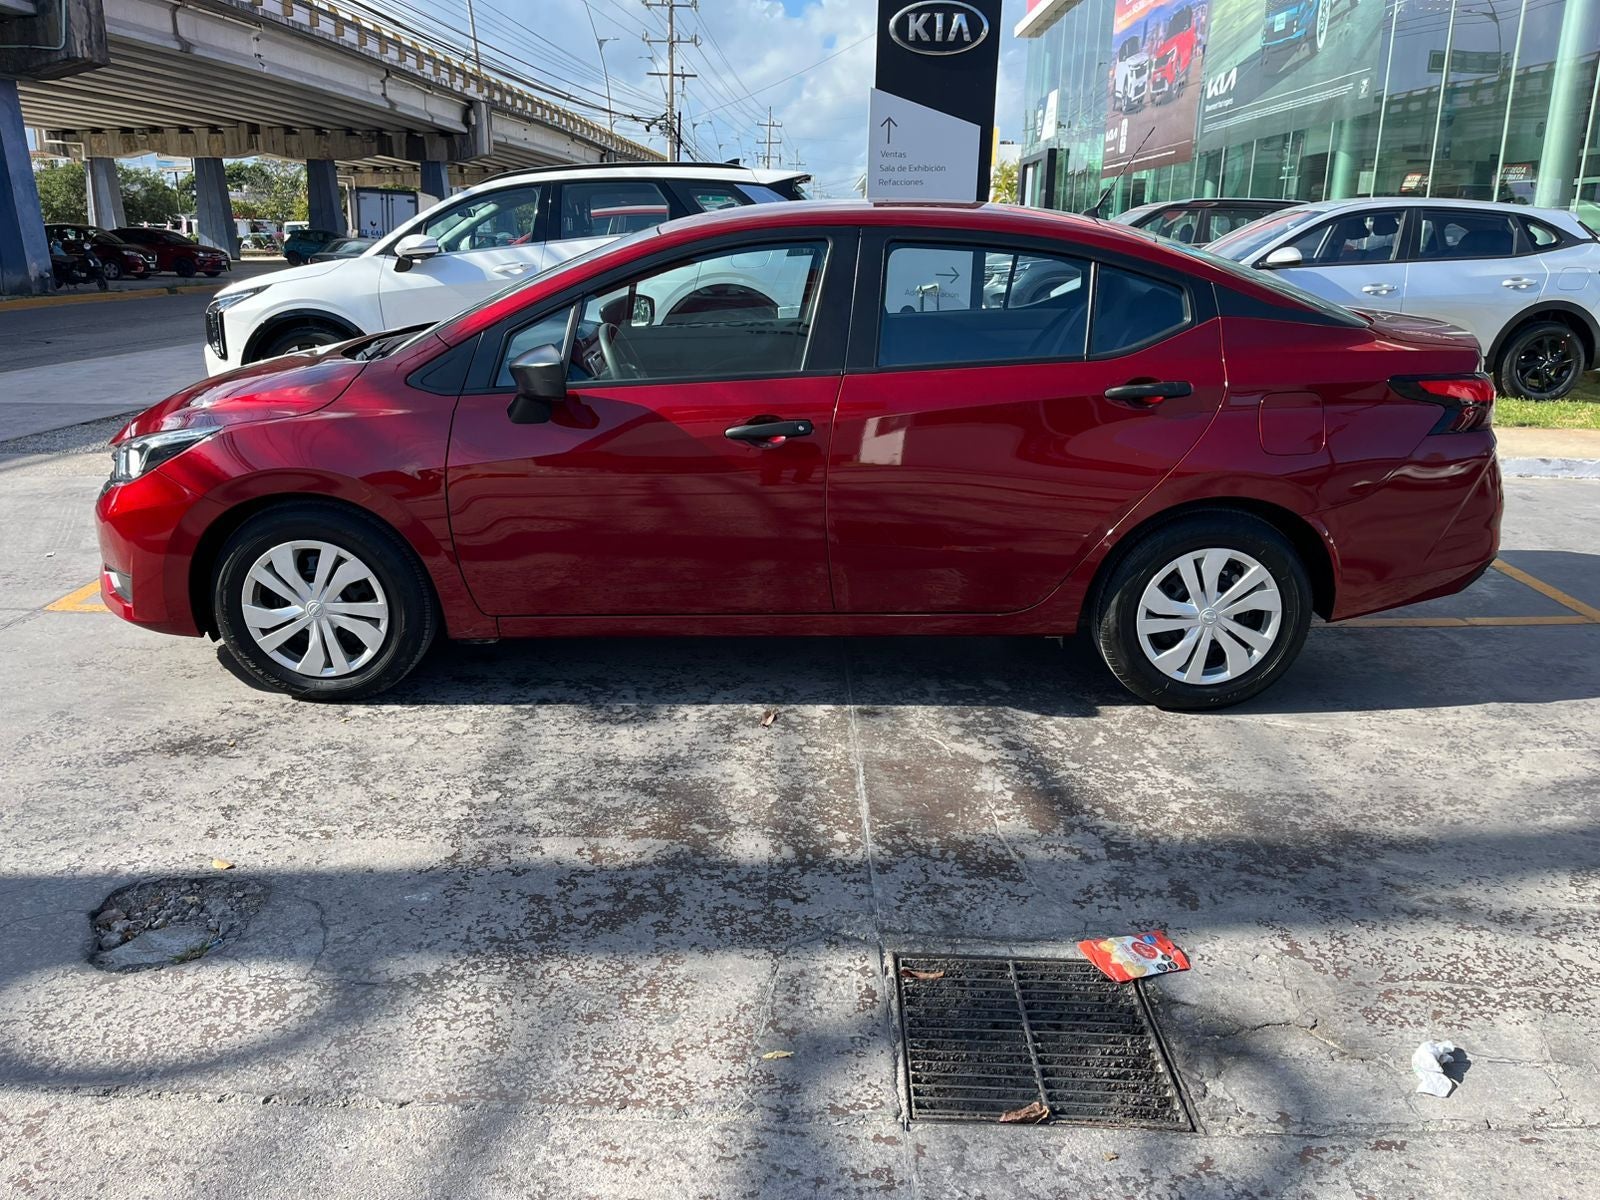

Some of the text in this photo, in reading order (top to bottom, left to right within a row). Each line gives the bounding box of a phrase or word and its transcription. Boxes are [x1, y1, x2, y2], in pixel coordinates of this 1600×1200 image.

[907, 12, 972, 43] KIA
[1206, 67, 1238, 99] KIA
[880, 150, 907, 159] Ventas
[879, 164, 947, 173] Sala de Exhibición
[878, 178, 924, 187] Refacciones
